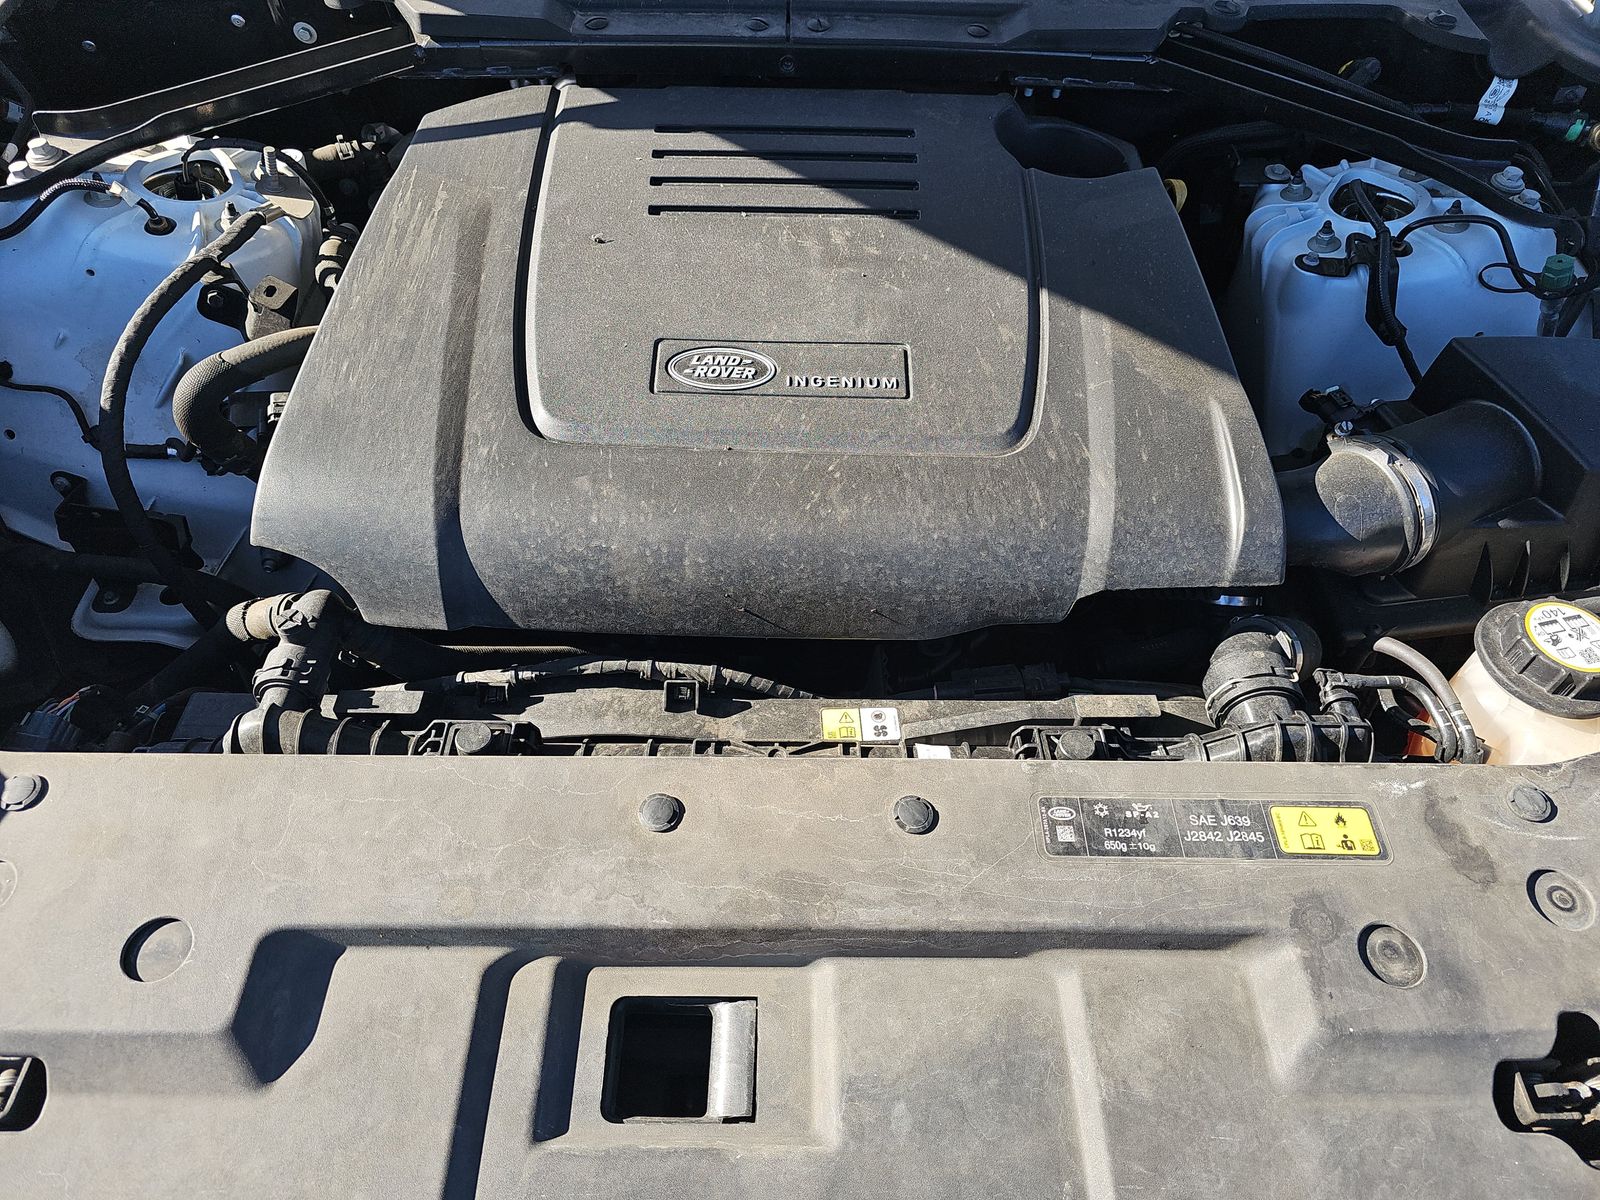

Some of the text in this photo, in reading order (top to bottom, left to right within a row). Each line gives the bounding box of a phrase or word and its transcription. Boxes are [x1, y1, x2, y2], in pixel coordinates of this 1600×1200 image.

[690, 354, 743, 367] LAND
[693, 366, 757, 380] ROVER
[785, 374, 900, 390] INGENIUM
[1541, 607, 1566, 619] 140
[1125, 810, 1160, 819] SP-A2
[1189, 814, 1251, 827] SAE J639
[1103, 827, 1147, 840] R1234yf
[1183, 830, 1265, 843] J2842 J2845
[1103, 840, 1128, 853] 650g
